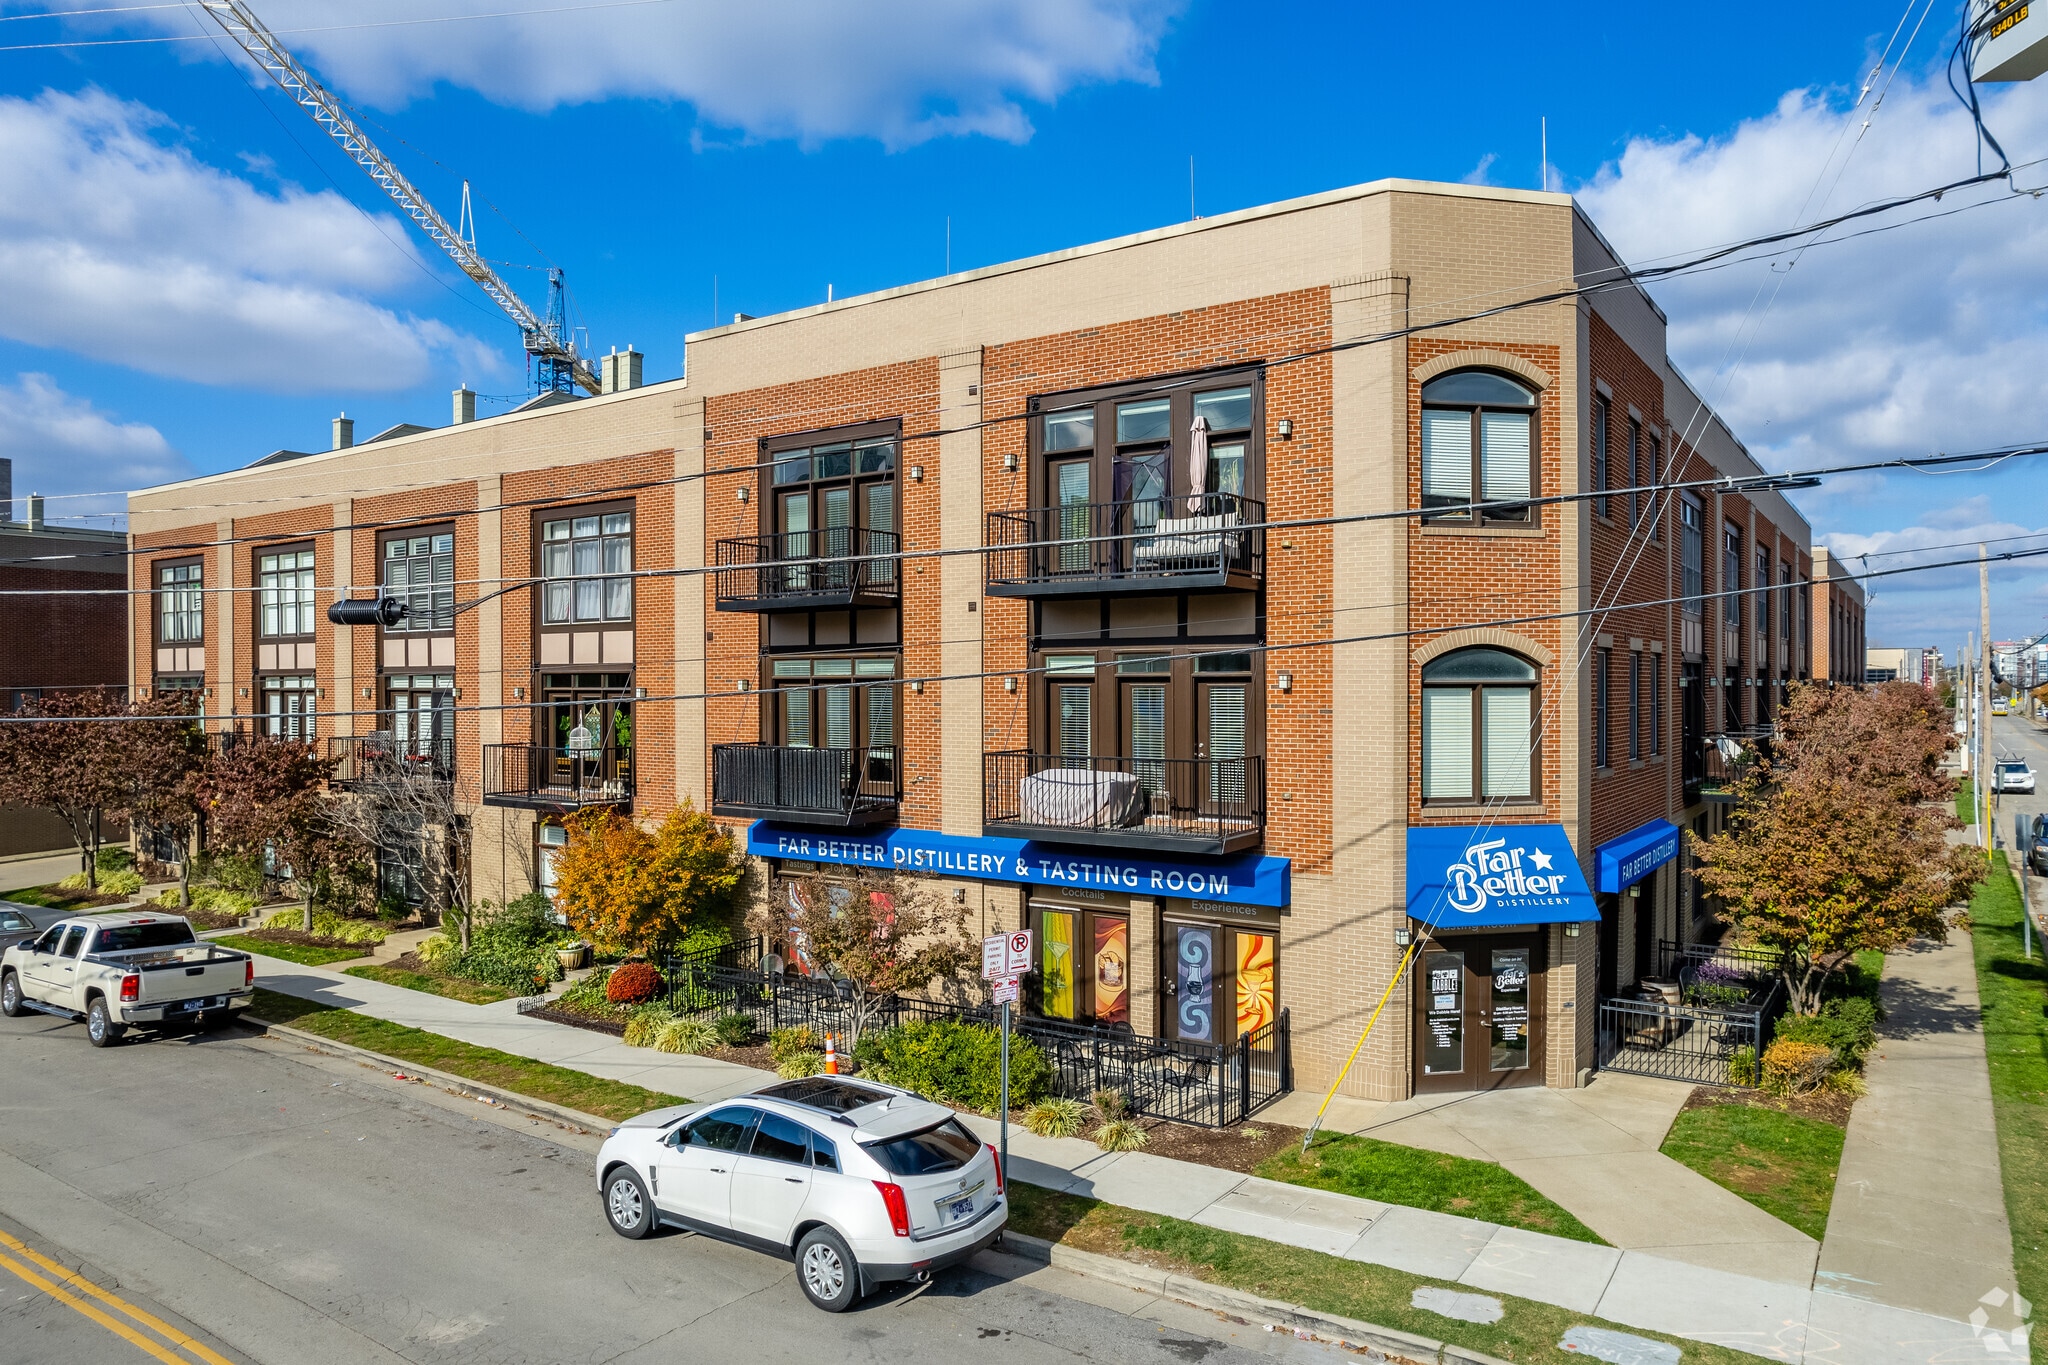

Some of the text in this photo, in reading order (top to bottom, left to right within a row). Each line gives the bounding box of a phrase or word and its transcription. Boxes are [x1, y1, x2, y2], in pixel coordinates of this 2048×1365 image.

[2015, 6, 2027, 22] LB
[1465, 836, 1526, 876] Far
[1622, 837, 1676, 883] FAR BETTER DISTILLERY
[779, 837, 1229, 895] FAR BETTER DISTILLERY & TASTING ROOM
[785, 859, 815, 870] Tastings
[1061, 887, 1105, 900] Cocktails
[1446, 863, 1567, 914] Better
[1191, 900, 1257, 916] Experiences
[1497, 897, 1570, 907] DISTILLERY
[1396, 948, 1405, 985] 30
[1503, 968, 1518, 978] Far
[1495, 975, 1526, 989] Better
